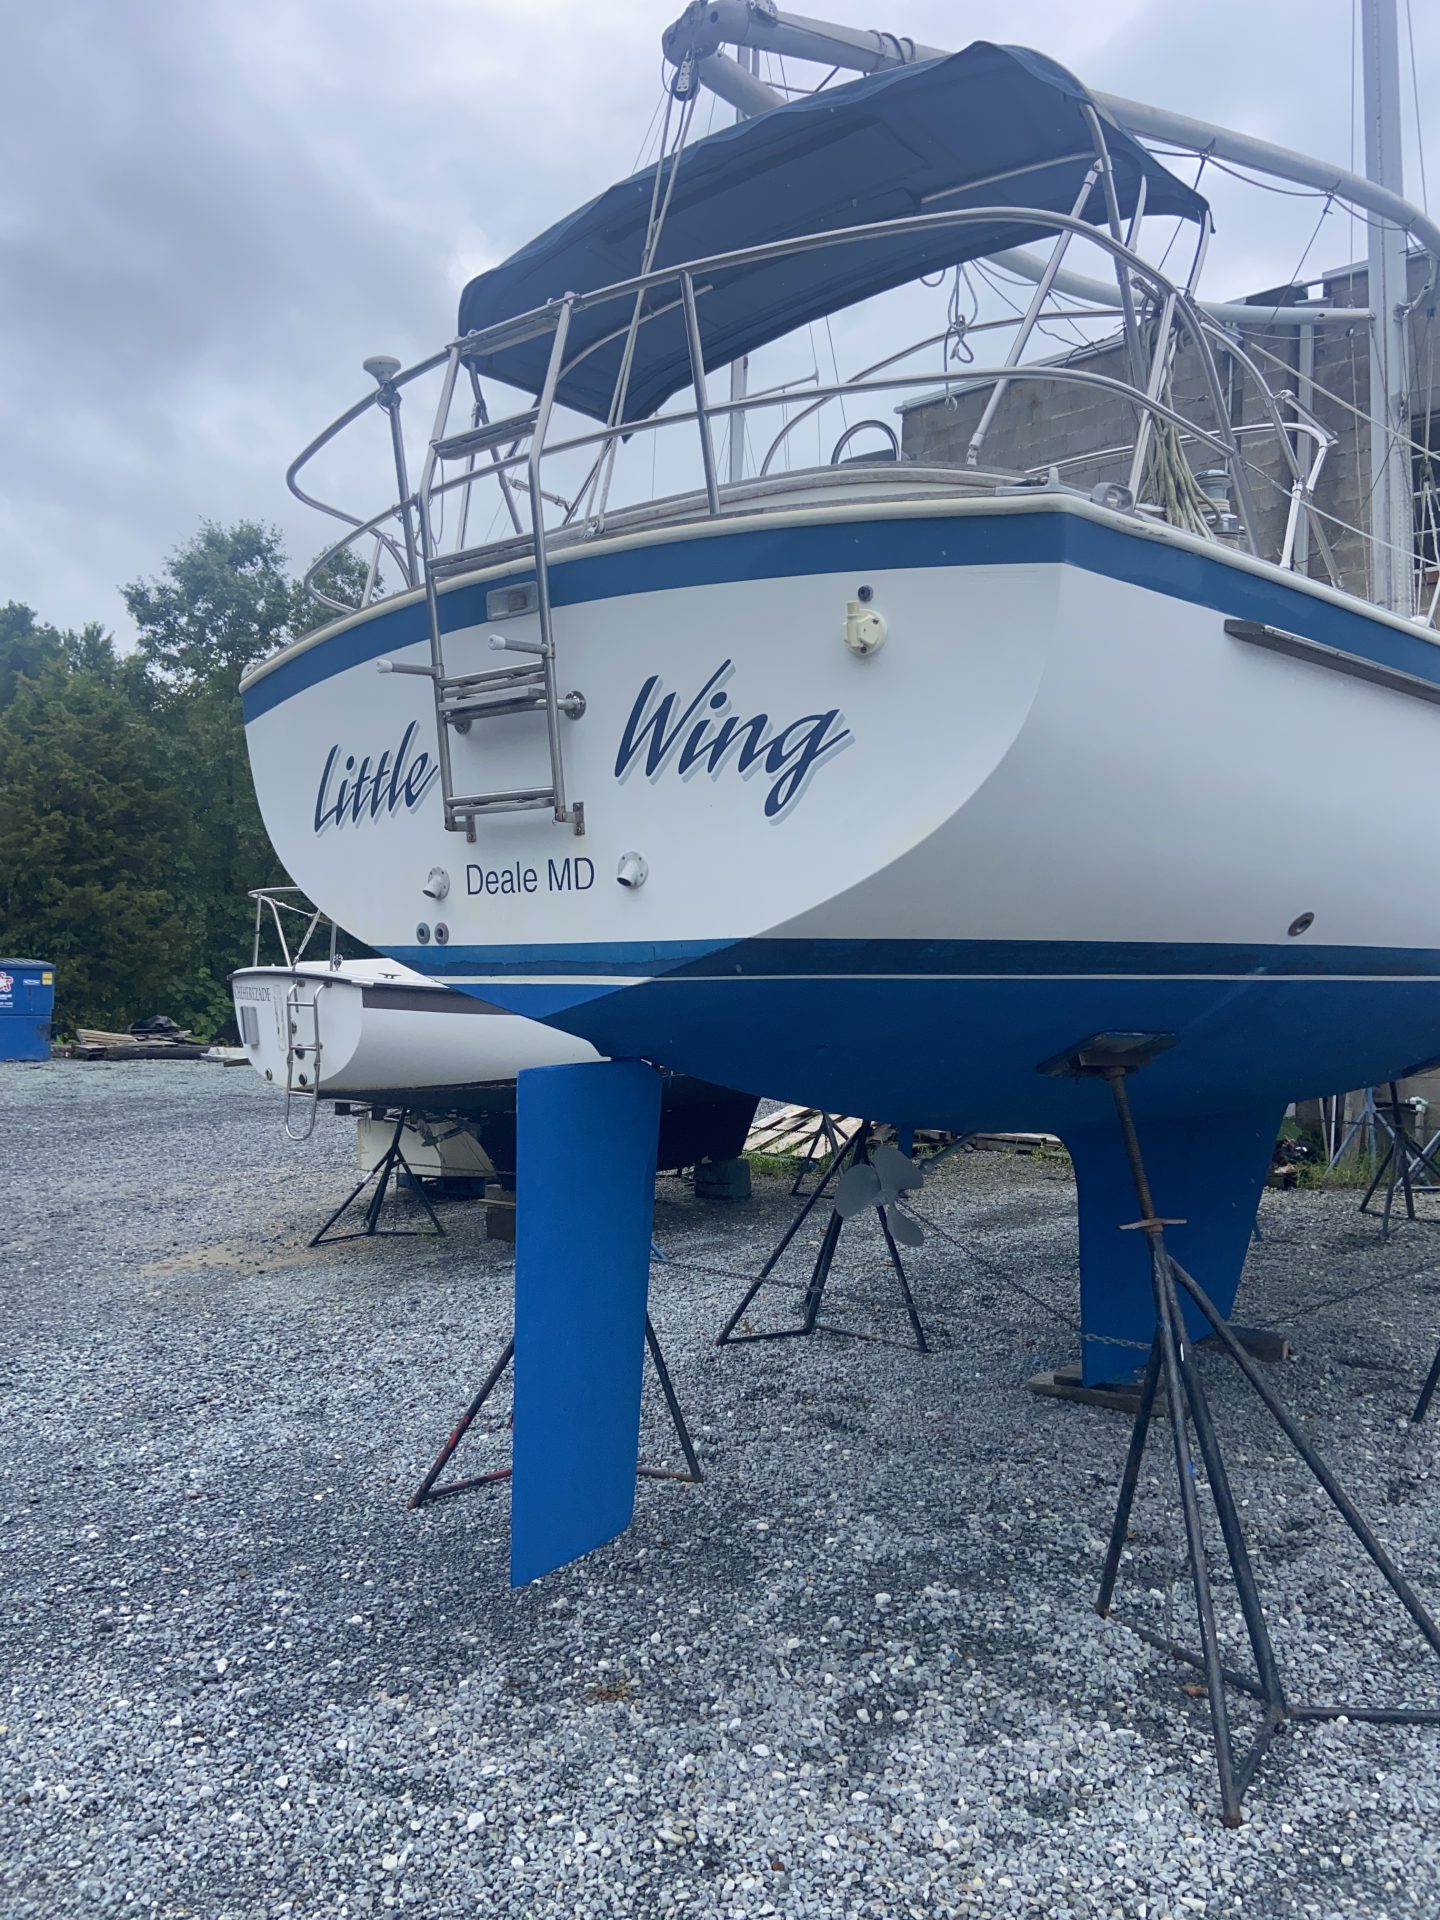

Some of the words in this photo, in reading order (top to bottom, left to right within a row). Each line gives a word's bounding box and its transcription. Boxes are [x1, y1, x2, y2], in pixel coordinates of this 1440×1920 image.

[314, 719, 440, 836] Little
[614, 658, 853, 823] Wing
[466, 861, 538, 895] Deale
[547, 857, 595, 892] MD
